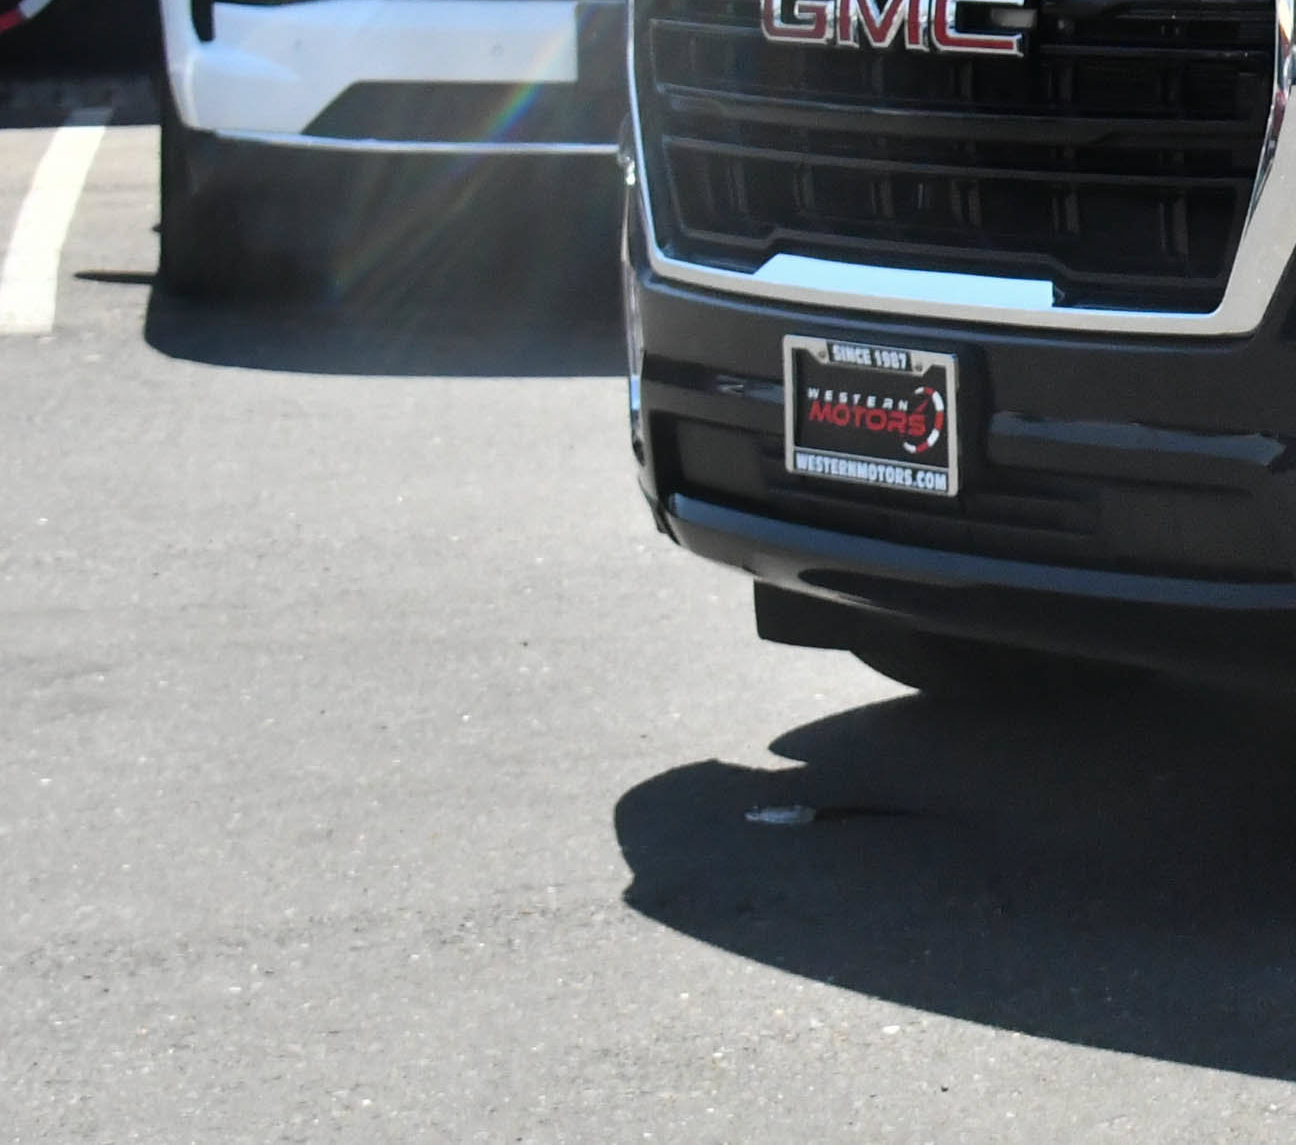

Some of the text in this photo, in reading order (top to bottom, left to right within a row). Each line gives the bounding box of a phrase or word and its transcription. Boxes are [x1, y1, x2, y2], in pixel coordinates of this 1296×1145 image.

[832, 343, 872, 366] SINCE
[807, 387, 909, 412] WESTERN
[808, 400, 927, 437] MOTORS
[796, 453, 947, 491] WESTERNMOTORS.COM
